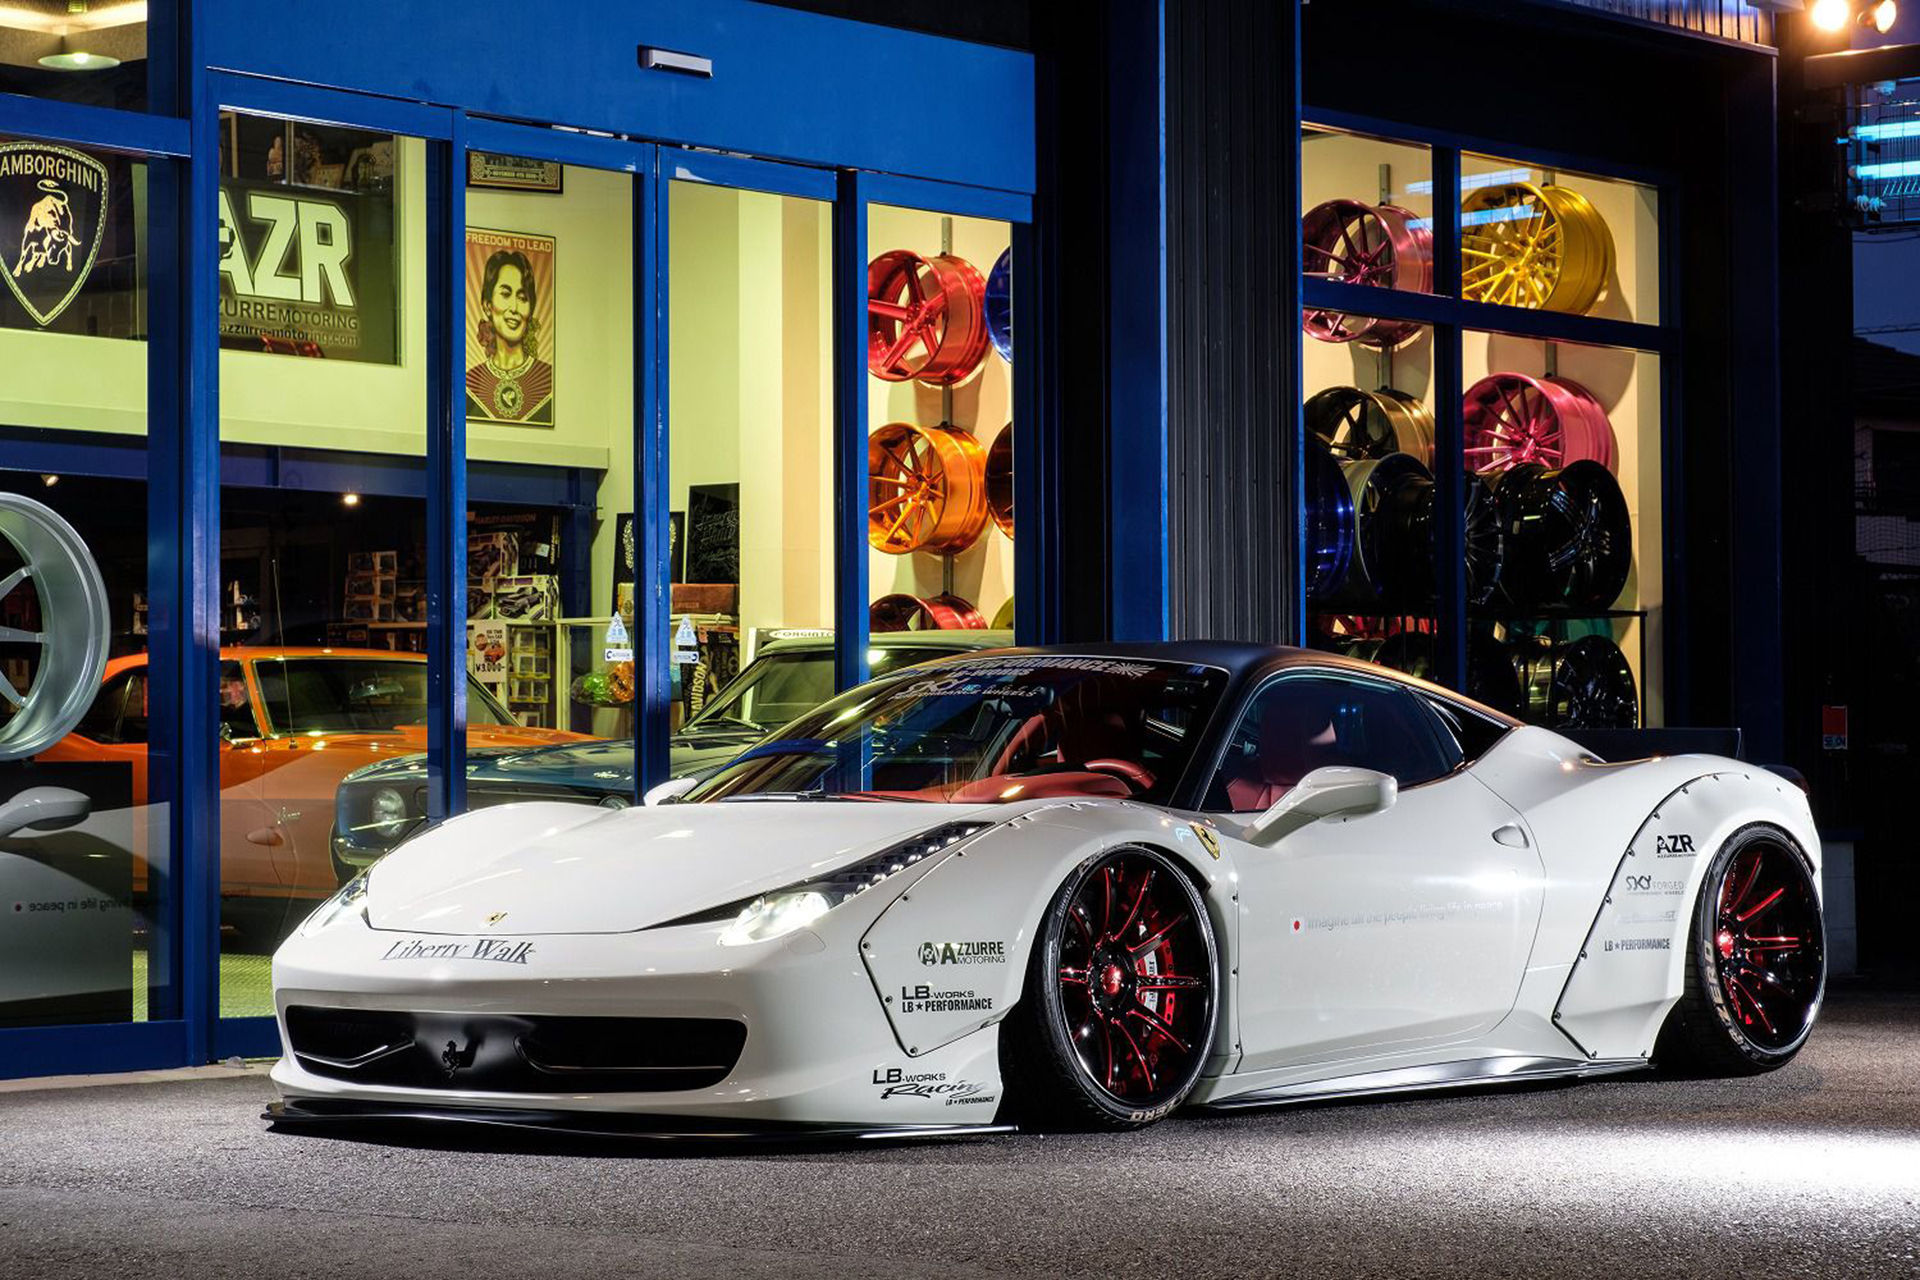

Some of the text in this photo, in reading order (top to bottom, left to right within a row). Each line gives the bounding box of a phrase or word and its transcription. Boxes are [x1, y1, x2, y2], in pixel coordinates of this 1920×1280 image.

[0, 154, 98, 193] AMBORGHINI
[466, 233, 552, 252] FREEDOM TO LEAD
[1656, 834, 1696, 853] AZR
[1652, 881, 1684, 890] FORGED
[380, 938, 537, 964] Liberty Walk
[940, 941, 1005, 965] AZZURRE
[957, 955, 1006, 965] MOTORING
